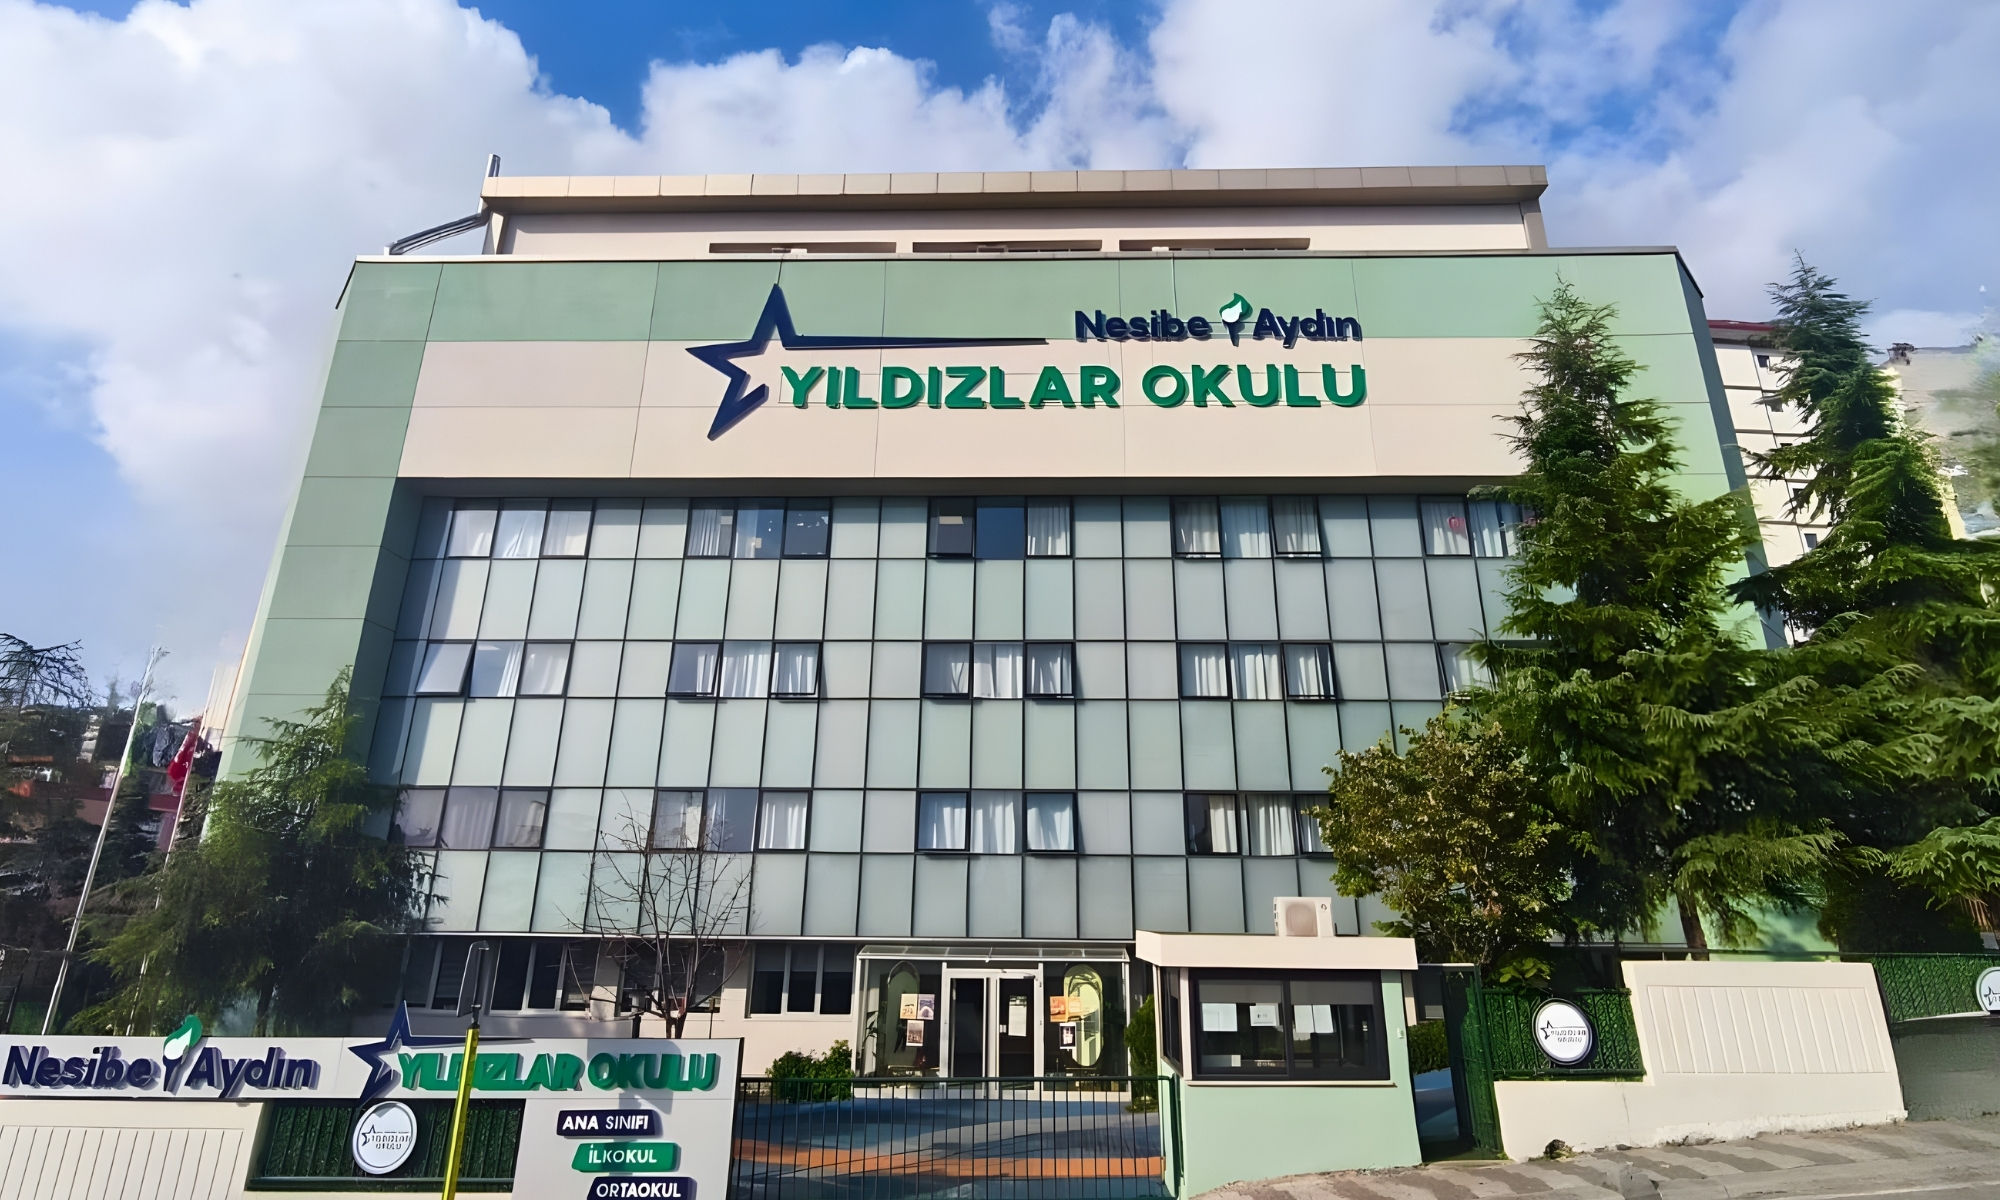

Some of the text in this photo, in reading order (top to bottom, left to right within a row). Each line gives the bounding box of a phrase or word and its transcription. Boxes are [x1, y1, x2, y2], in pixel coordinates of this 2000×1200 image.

[1074, 308, 1363, 350] Nesibe Aydın
[780, 363, 1368, 409] YILDIZLAR OKULU
[2, 1045, 322, 1098] Nesibe Aydın
[588, 1052, 721, 1091] OKULU
[562, 1115, 649, 1130] ANA SINIFI
[588, 1144, 658, 1163] İLKOKUL
[596, 1182, 682, 1198] ORTAOKUL
